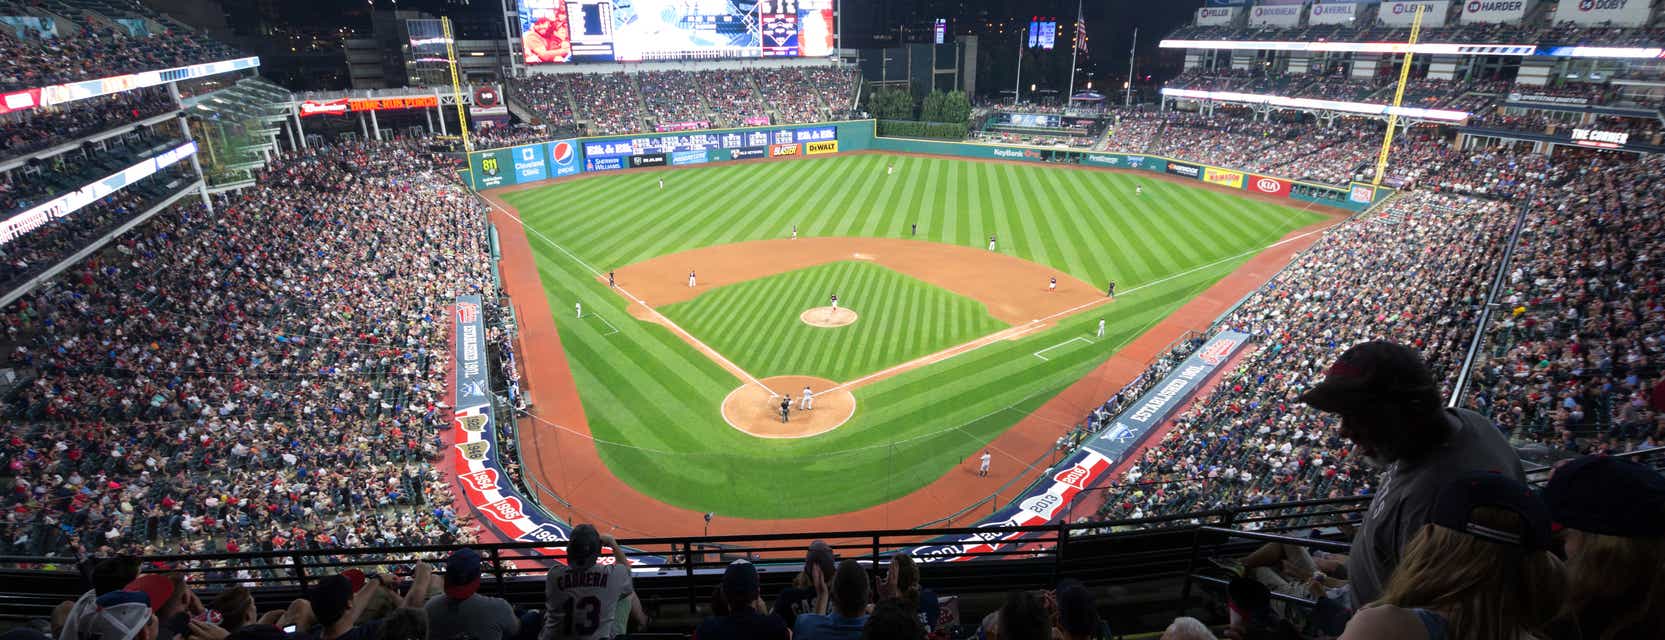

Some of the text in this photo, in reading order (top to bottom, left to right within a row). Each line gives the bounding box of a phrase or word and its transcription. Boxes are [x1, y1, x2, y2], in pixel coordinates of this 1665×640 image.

[1481, 1, 1521, 11] HARDER
[482, 159, 497, 171] 811
[1030, 493, 1058, 514] 2013
